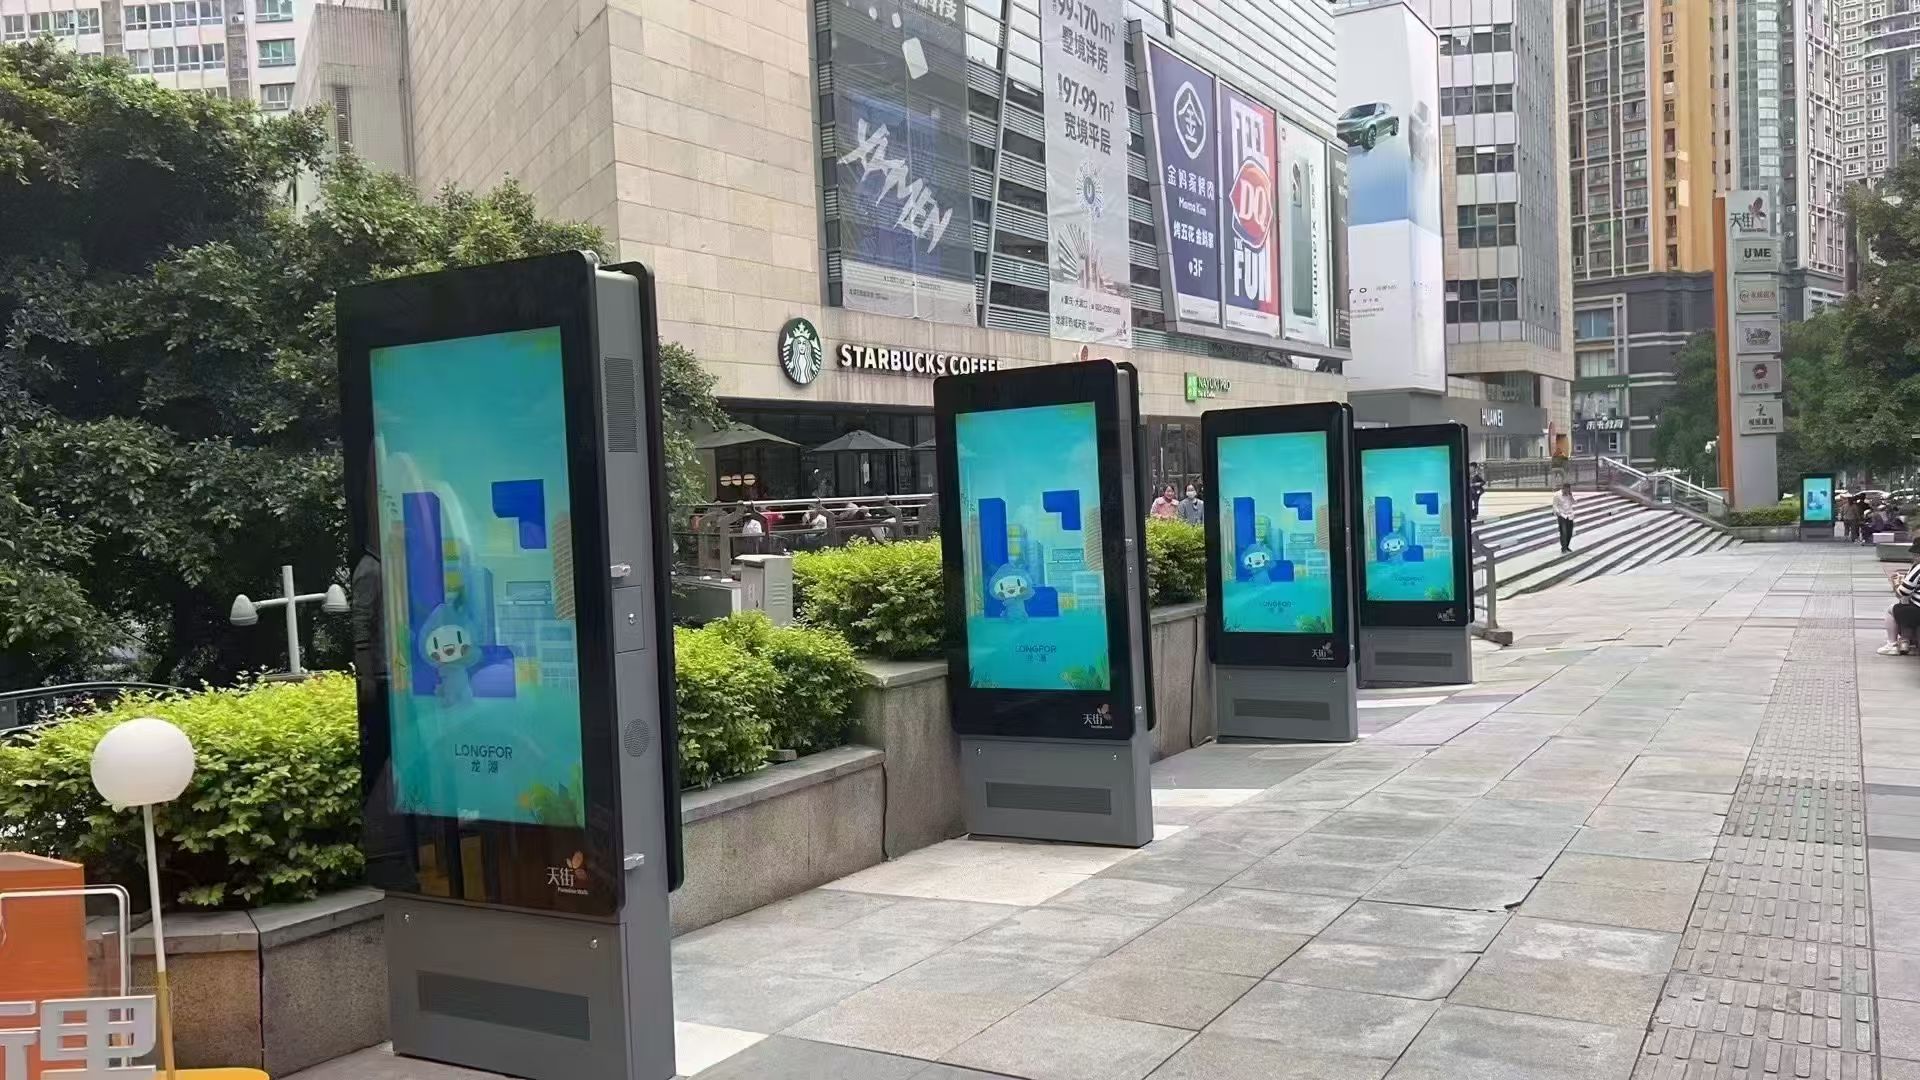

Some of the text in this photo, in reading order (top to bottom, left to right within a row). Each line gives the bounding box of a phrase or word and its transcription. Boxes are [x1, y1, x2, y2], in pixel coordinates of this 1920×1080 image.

[1062, 25, 1109, 73] 墅境洋房
[1064, 111, 1111, 156] 宽境平层
[1729, 212, 1755, 229] 天街
[1233, 229, 1272, 304] FUN
[841, 343, 946, 375] STARBUCKS
[1481, 407, 1504, 427] HUAWEI
[1082, 713, 1103, 725] 天街
[454, 743, 513, 760] LONGFOR
[546, 866, 575, 888] 天街
